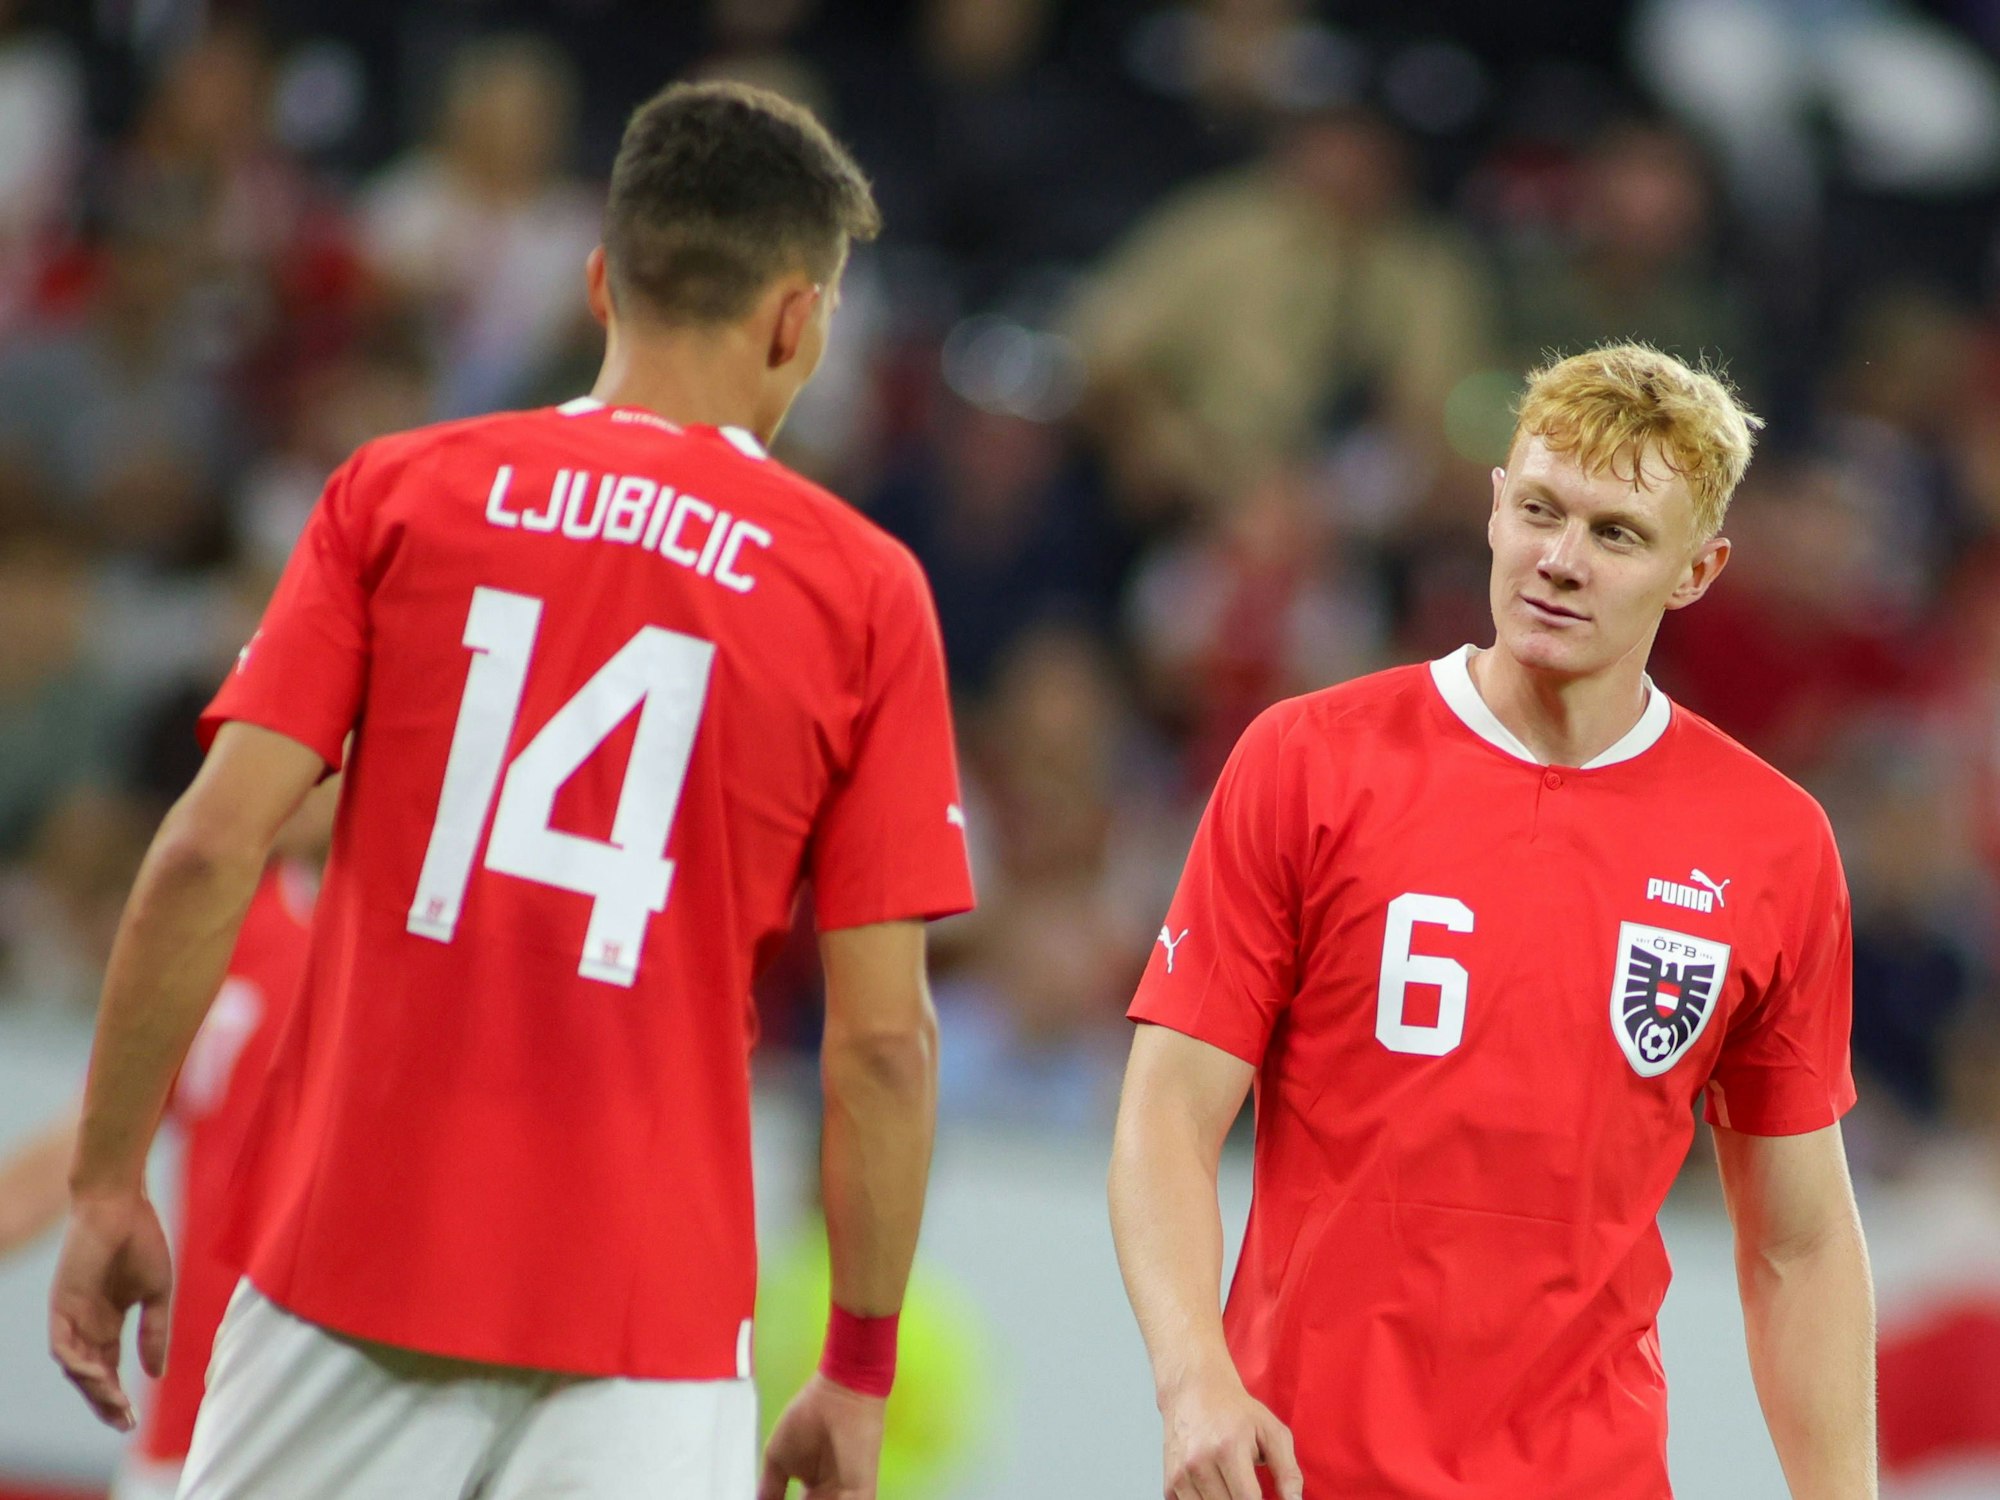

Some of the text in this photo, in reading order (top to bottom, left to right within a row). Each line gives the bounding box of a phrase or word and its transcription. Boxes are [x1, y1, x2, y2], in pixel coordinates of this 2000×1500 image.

[486, 464, 772, 594] LJUBICIC
[407, 587, 715, 987] 14
[1646, 877, 1714, 914] PUMA
[1653, 936, 1697, 959] ÖFB
[1376, 893, 1475, 1056] 6
